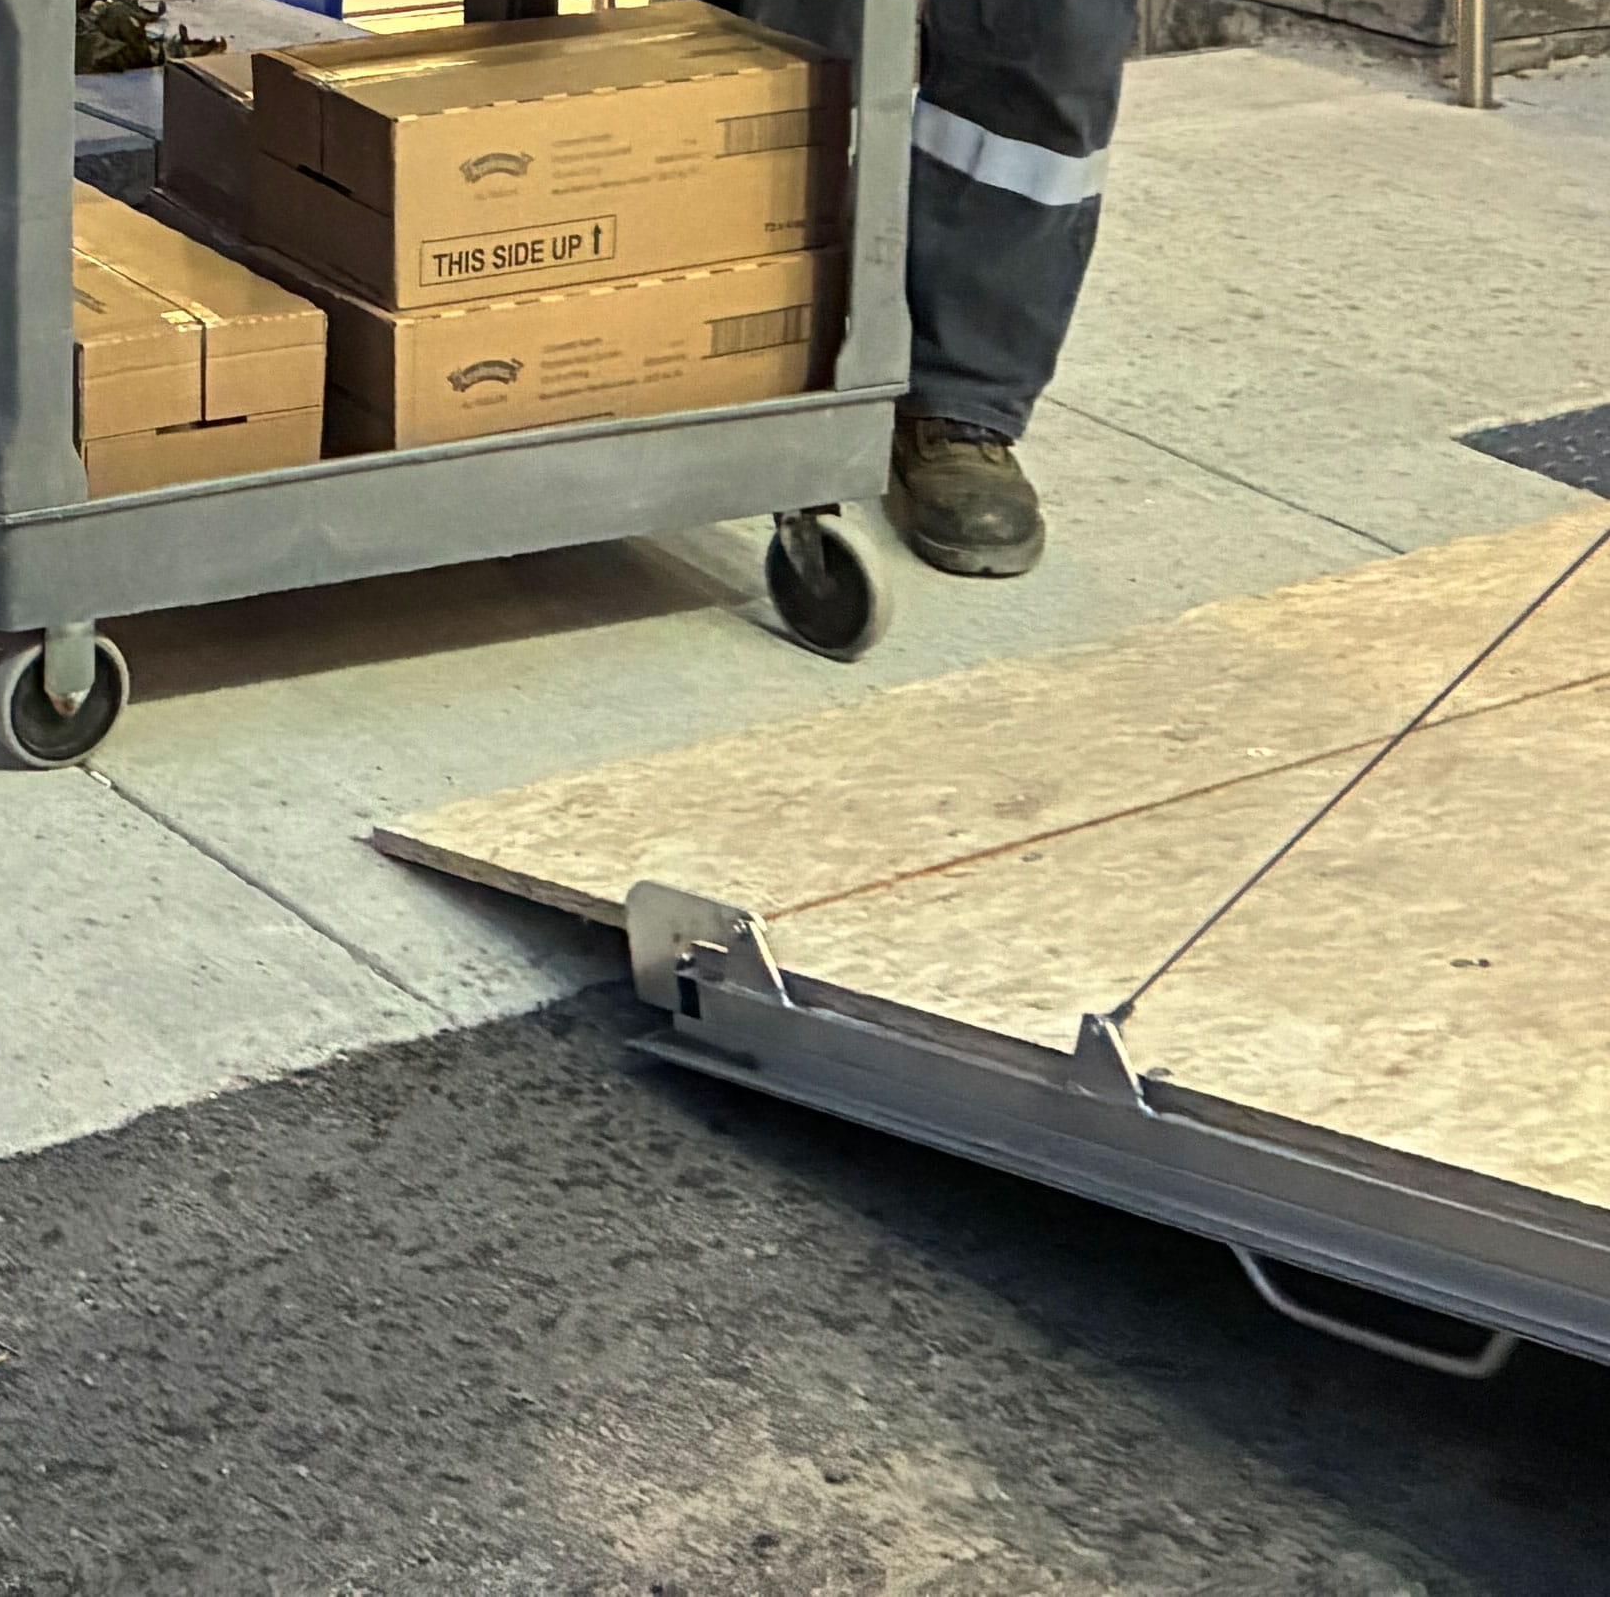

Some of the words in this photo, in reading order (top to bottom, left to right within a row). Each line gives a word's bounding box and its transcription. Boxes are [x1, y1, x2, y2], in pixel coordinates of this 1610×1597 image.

[433, 248, 485, 278] THIS
[492, 241, 545, 269] SIDE
[552, 234, 584, 261] UP
